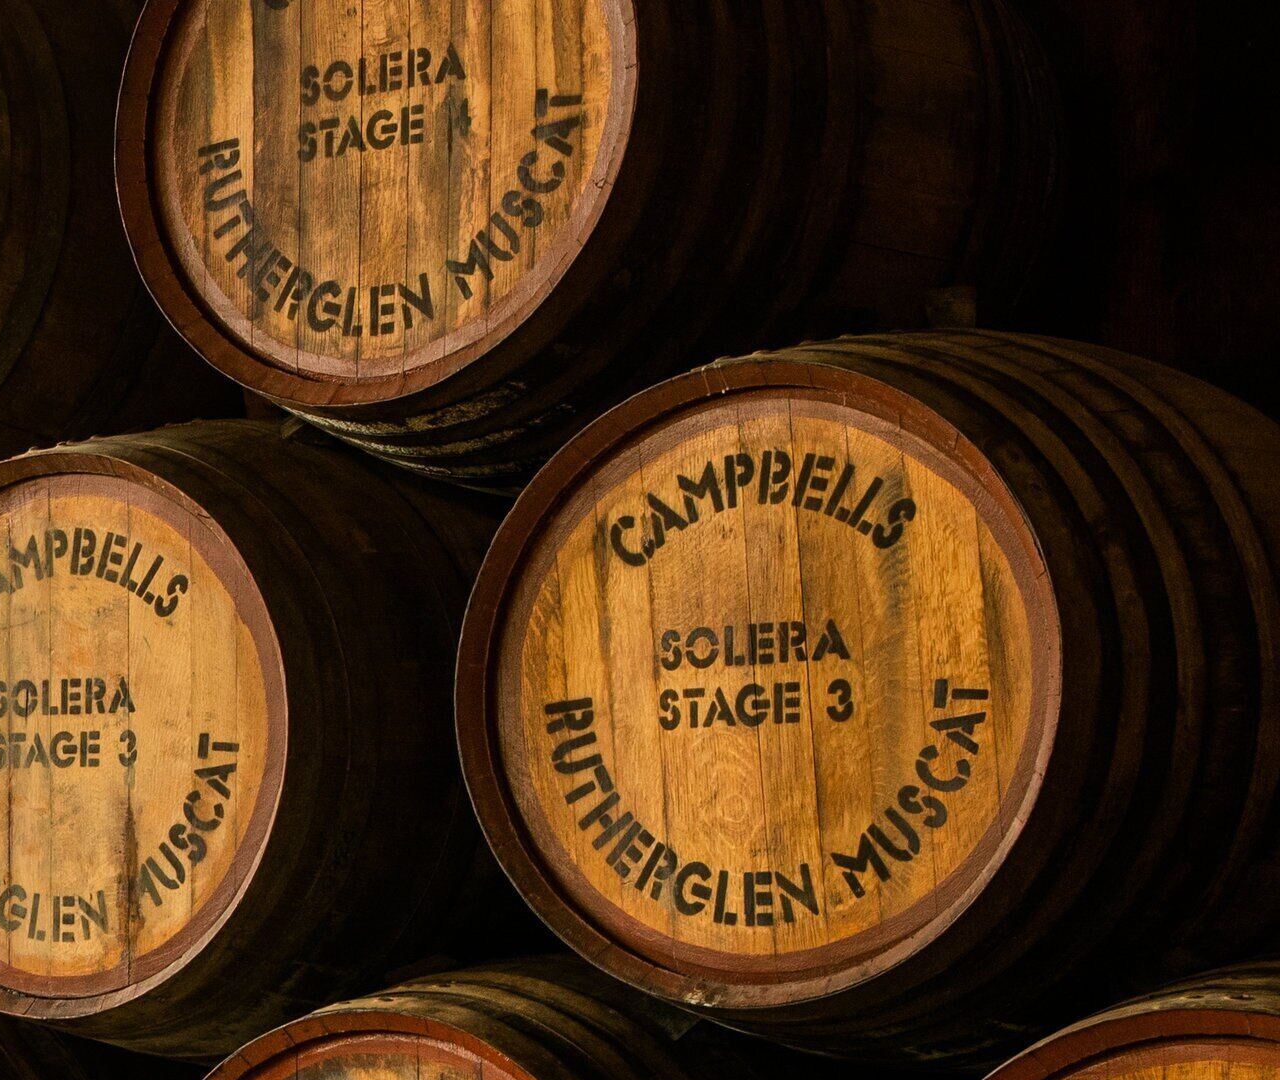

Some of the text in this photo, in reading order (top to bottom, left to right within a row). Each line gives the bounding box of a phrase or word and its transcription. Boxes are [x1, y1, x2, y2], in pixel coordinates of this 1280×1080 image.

[301, 41, 466, 106] SOLERA
[298, 105, 424, 162] STAGE
[198, 89, 583, 338] RUTHERGLEN MUSCAT
[610, 451, 916, 567] CAMPBELLS
[661, 618, 850, 672] SOLERA
[659, 678, 853, 731] STAGE 3
[120, 730, 137, 767] 3
[545, 678, 989, 928] RUTHERGLEN MUSCAT
